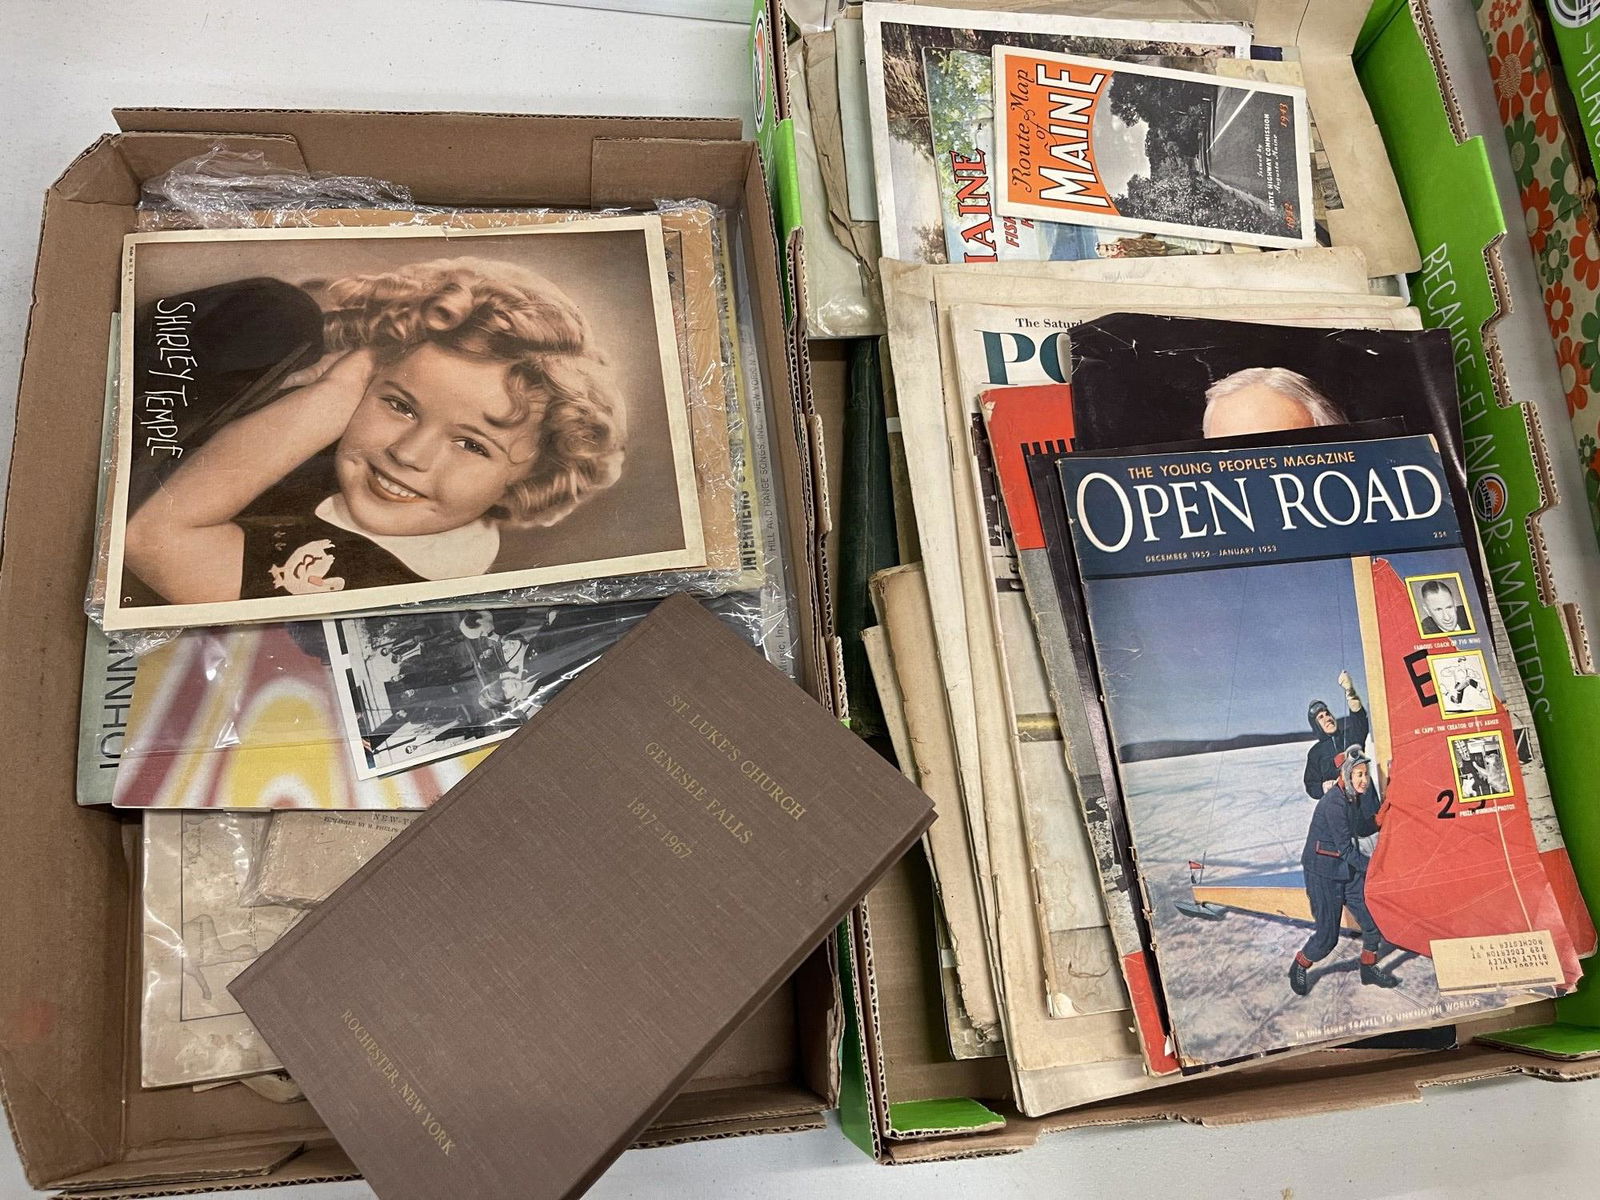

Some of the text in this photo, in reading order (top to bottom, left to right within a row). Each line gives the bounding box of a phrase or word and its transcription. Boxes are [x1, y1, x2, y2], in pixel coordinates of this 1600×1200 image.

[1010, 69, 1035, 112] Map
[1012, 123, 1031, 192] Route
[1036, 64, 1111, 208] MAINE
[1265, 158, 1274, 189] HIGHWAY
[1273, 163, 1281, 194] Augusta
[949, 148, 998, 263] AINE
[1267, 191, 1275, 211] STATE
[1015, 318, 1084, 329] The Saturd
[140, 299, 198, 459] SHIRLEY TEMPLE
[973, 329, 1072, 386] PO
[1128, 450, 1356, 480] THE YOUNG PEOPLE'S MAGAZINE
[761, 477, 772, 510] RANGE
[1076, 464, 1442, 553] OPEN ROAD
[1477, 477, 1492, 522] SUNSET
[767, 532, 776, 551] HILL
[1145, 553, 1188, 563] DECEMBER
[1219, 546, 1254, 556] JANUARY
[99, 640, 138, 769] JOHNN
[667, 694, 807, 821] ST. LUKE'S CHURCH
[645, 741, 753, 845] GENESEE FALLS
[1395, 1005, 1442, 1021] UNKNOWN
[1445, 998, 1480, 1012] WORLDS
[341, 1009, 456, 1155] ROCHESTER, NEW YORK
